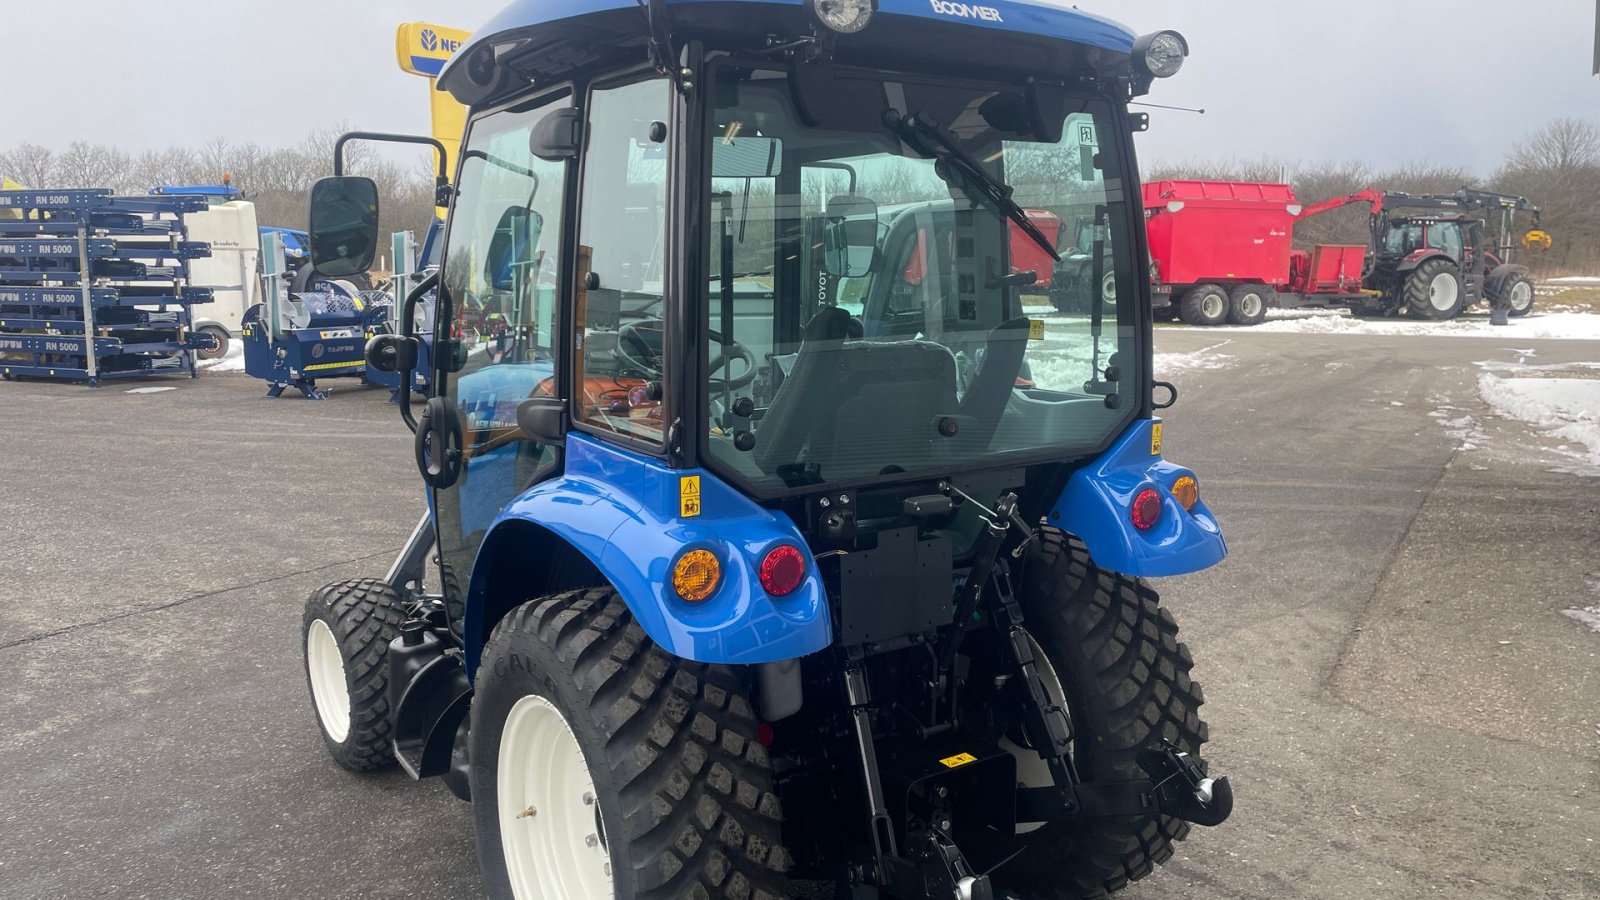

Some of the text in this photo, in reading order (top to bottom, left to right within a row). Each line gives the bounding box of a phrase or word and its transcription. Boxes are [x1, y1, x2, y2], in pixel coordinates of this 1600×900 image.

[930, 0, 1004, 23] BOOMER
[35, 195, 48, 204] RN
[49, 195, 69, 204] 5000
[39, 244, 51, 254] RN
[52, 244, 72, 253] 5000
[42, 293, 54, 303] RN
[55, 294, 75, 303] 5000
[45, 341, 57, 351] RN
[59, 342, 79, 352] 5000
